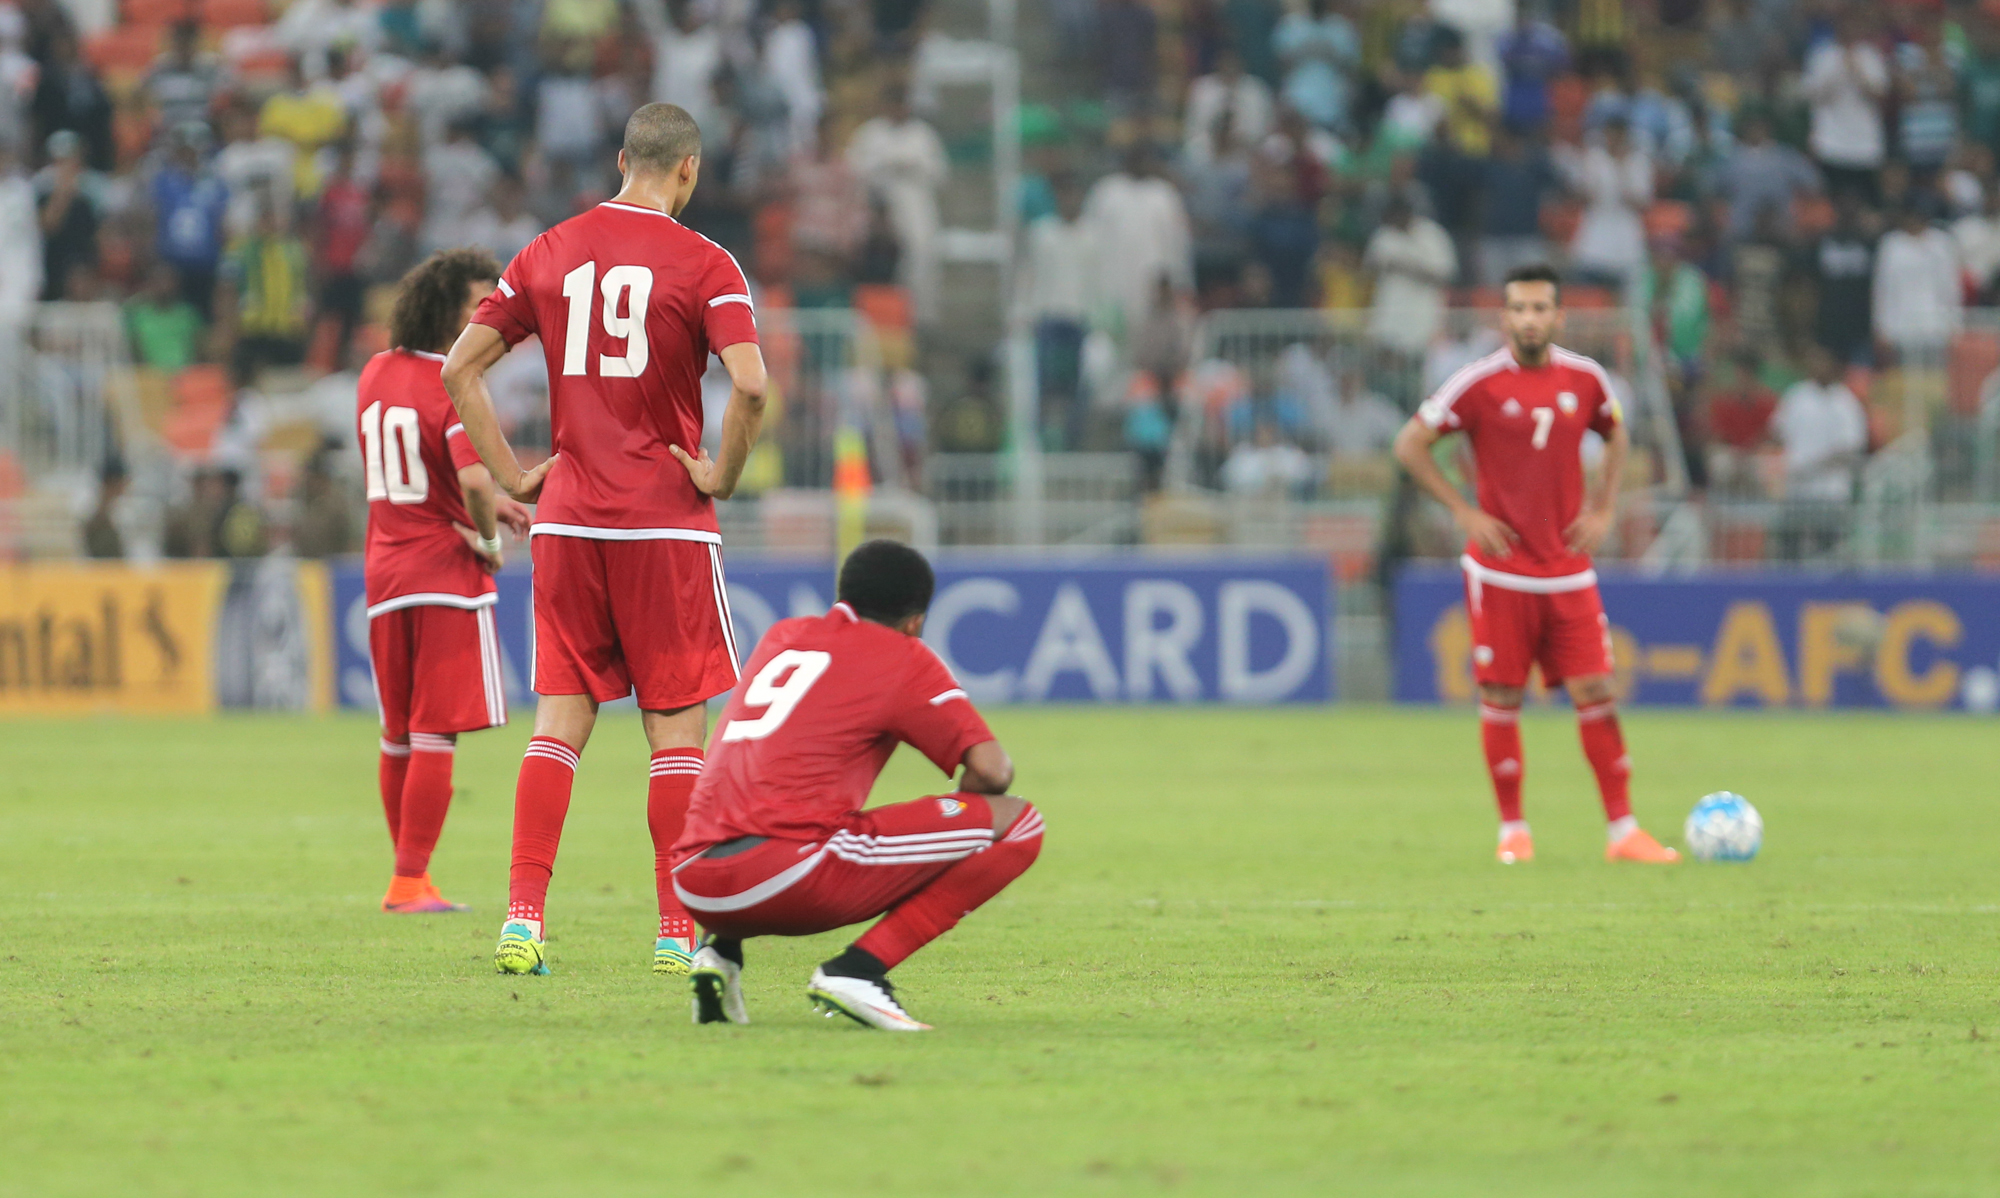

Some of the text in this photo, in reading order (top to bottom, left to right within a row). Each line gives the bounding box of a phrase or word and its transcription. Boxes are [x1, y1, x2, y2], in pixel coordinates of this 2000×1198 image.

[563, 260, 653, 377] 19
[360, 400, 429, 505] 10
[1530, 407, 1554, 450] 7
[922, 577, 1320, 702] CARD
[722, 649, 832, 741] 9
